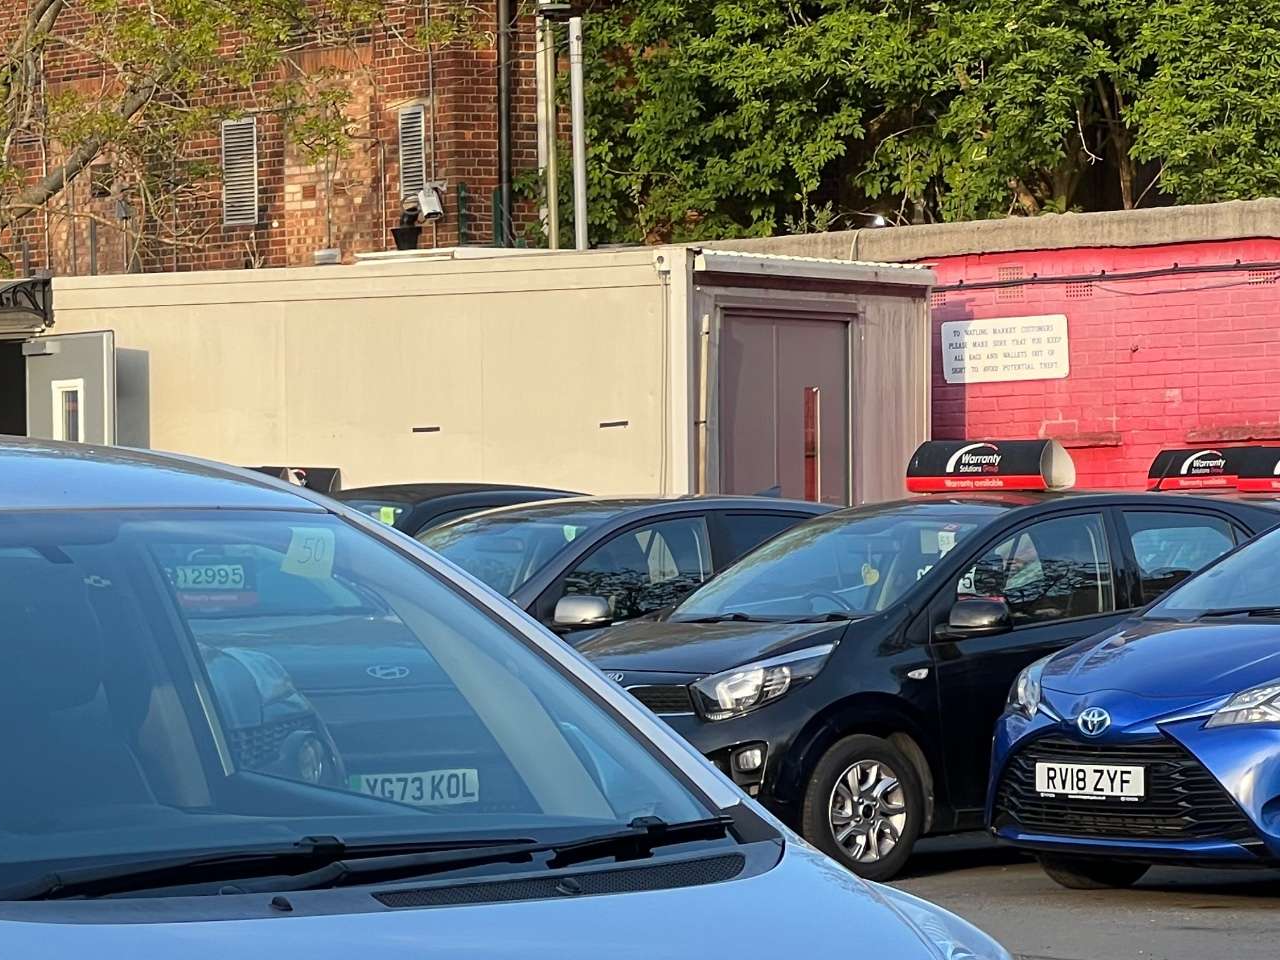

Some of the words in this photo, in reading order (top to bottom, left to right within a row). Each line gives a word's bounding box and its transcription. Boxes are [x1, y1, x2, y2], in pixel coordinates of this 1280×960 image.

[948, 342, 967, 350] PLEASE
[961, 454, 1001, 465] Warranty
[1193, 459, 1226, 469] Warranty
[960, 465, 982, 473] Solutions
[297, 536, 326, 564] 50
[1046, 767, 1087, 791] RV18
[1093, 769, 1132, 793] ZYF
[431, 772, 475, 801] KOL
